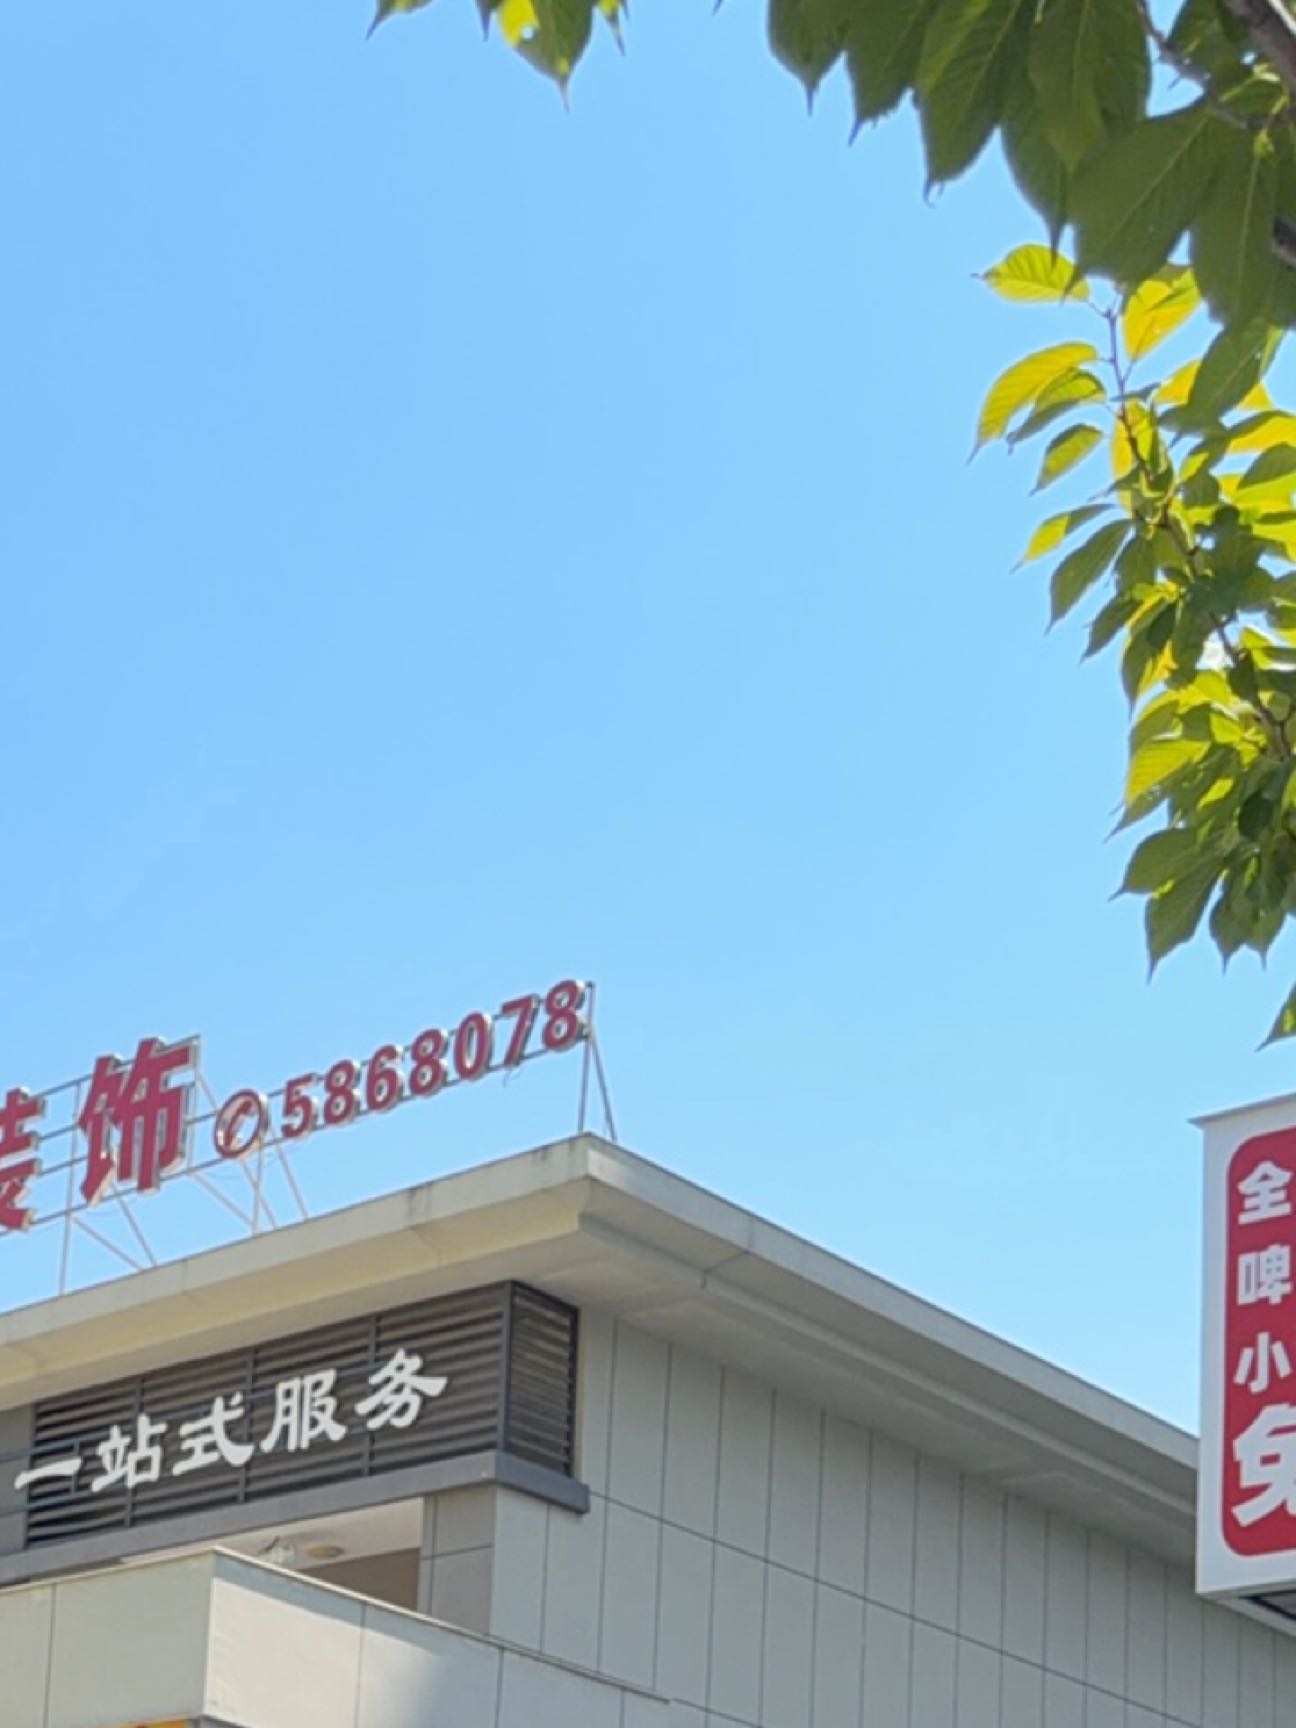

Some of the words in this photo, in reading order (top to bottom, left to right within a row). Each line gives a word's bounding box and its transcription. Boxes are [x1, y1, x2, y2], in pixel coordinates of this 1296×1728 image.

[281, 978, 584, 1139] 5868078
[1236, 1159, 1292, 1226] 全
[1232, 1330, 1292, 1394] 小
